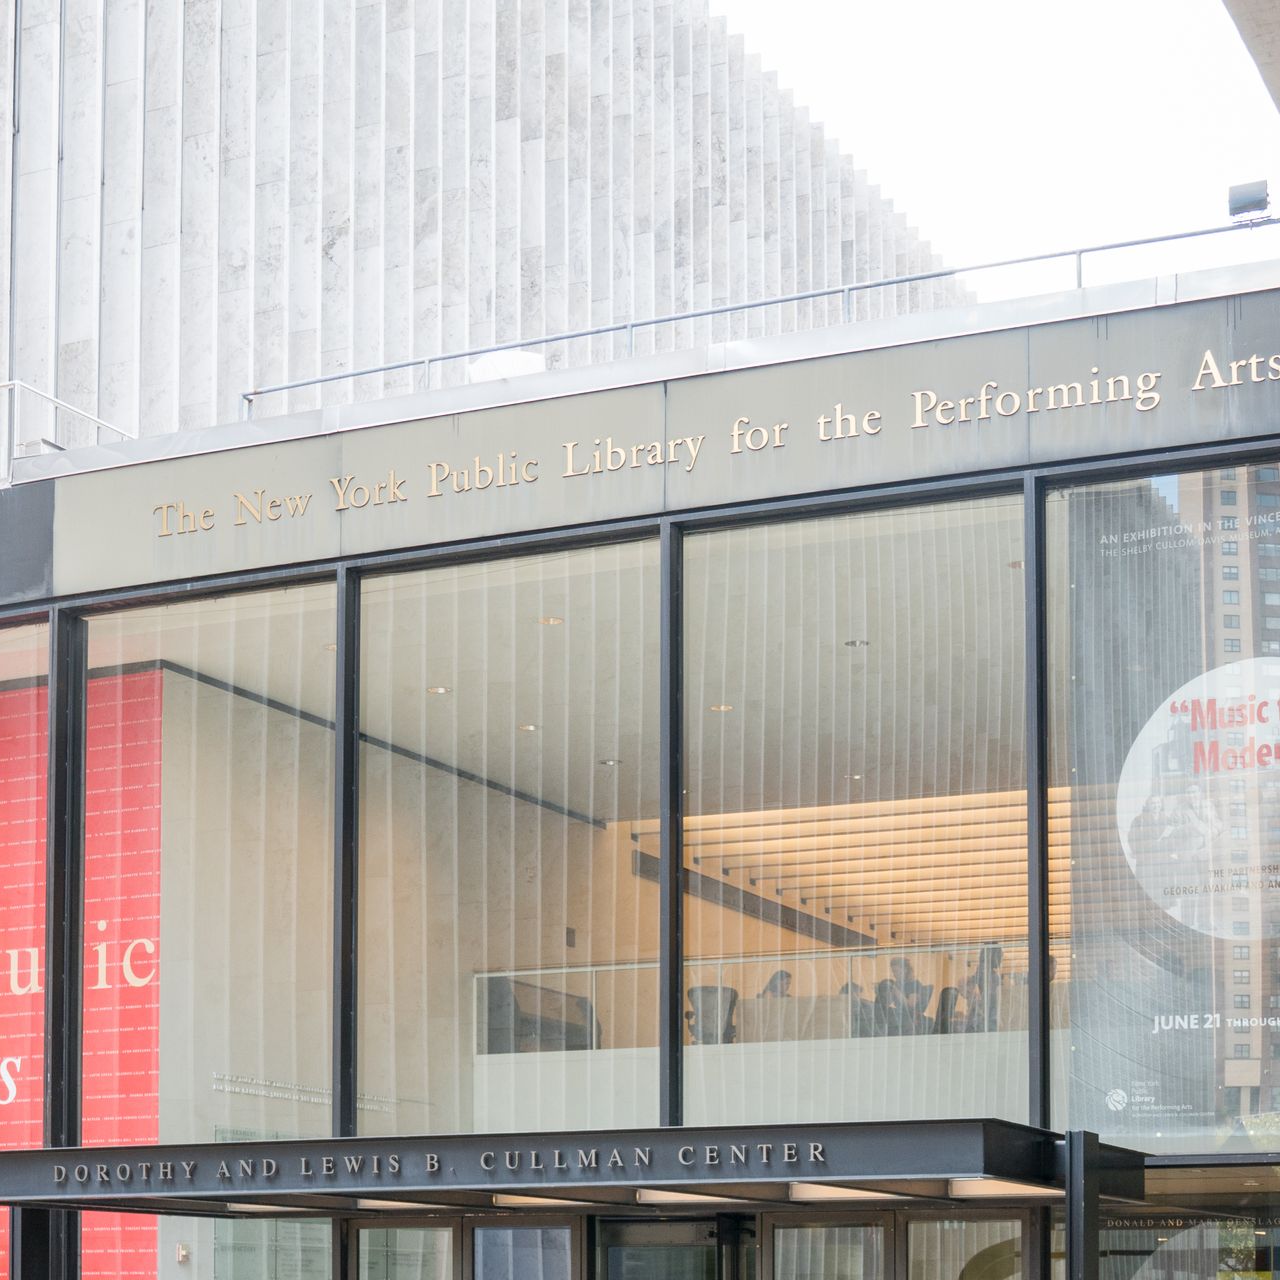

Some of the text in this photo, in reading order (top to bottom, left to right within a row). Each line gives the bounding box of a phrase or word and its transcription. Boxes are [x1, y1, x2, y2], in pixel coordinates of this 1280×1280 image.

[153, 500, 216, 538] The
[233, 488, 313, 526] New
[329, 470, 408, 511] York
[426, 450, 539, 498] Public
[562, 434, 705, 478] Library
[730, 416, 788, 454] for
[817, 403, 882, 441] the
[910, 366, 1162, 428] Performing
[1099, 533, 1119, 545] AN
[1123, 524, 1193, 543] EXHIBITION
[1216, 518, 1241, 530] THE
[1152, 1014, 1199, 1034] JUNE
[1203, 1013, 1221, 1028] 21
[1131, 1095, 1155, 1103] Library
[53, 1160, 195, 1183] DOROTHY
[216, 1158, 277, 1178] AND
[299, 1153, 401, 1176] LEWIS
[480, 1147, 652, 1171] CULLMAN
[677, 1141, 826, 1166] CENTER
[1107, 1219, 1154, 1228] DONALD
[1159, 1218, 1184, 1227] AND
